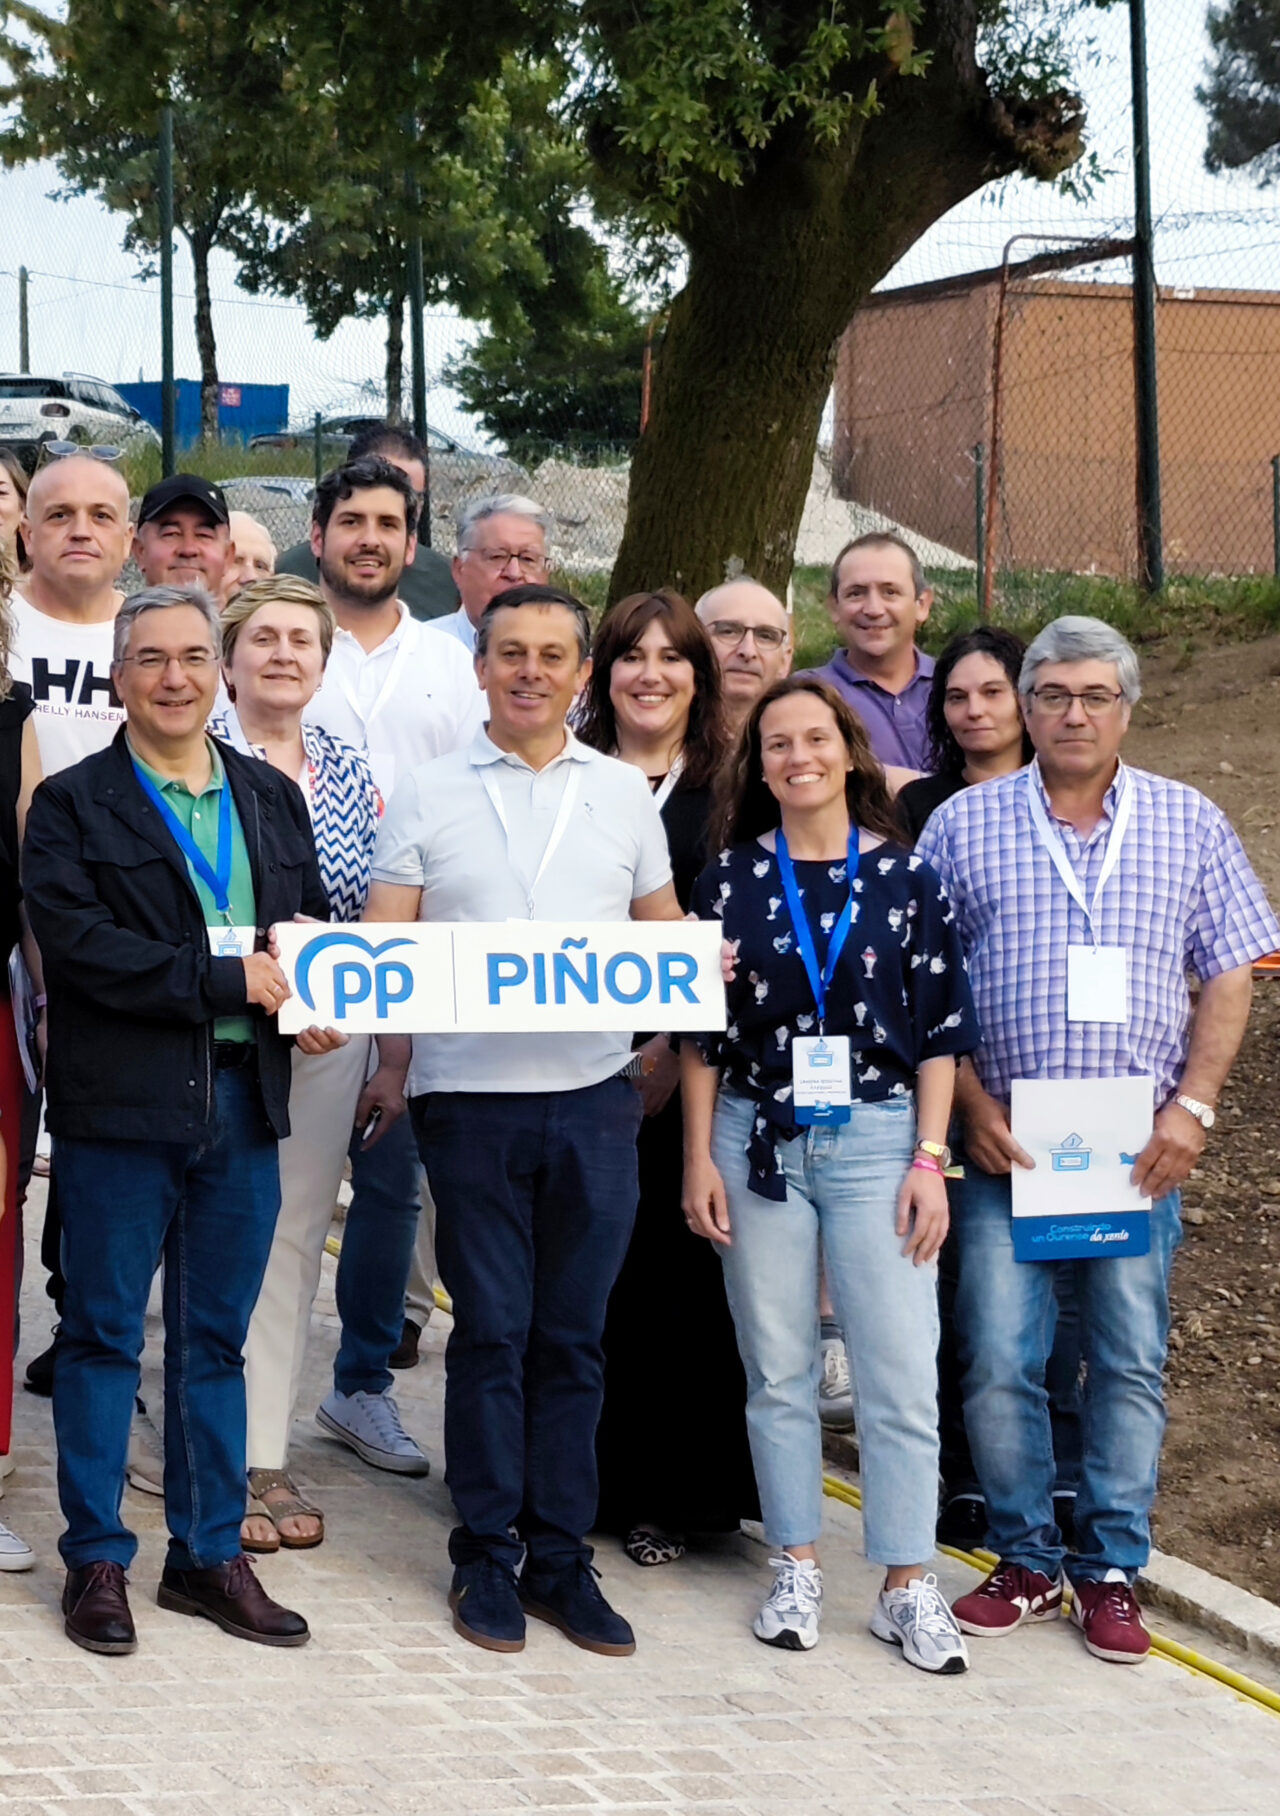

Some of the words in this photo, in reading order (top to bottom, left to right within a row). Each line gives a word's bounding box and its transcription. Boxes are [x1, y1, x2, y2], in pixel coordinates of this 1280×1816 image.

[75, 708, 124, 721] HANSEN
[332, 960, 414, 1019] pp
[486, 936, 701, 1005] PIÑOR
[1046, 1232, 1089, 1242] Ourense
[1089, 1228, 1102, 1242] da
